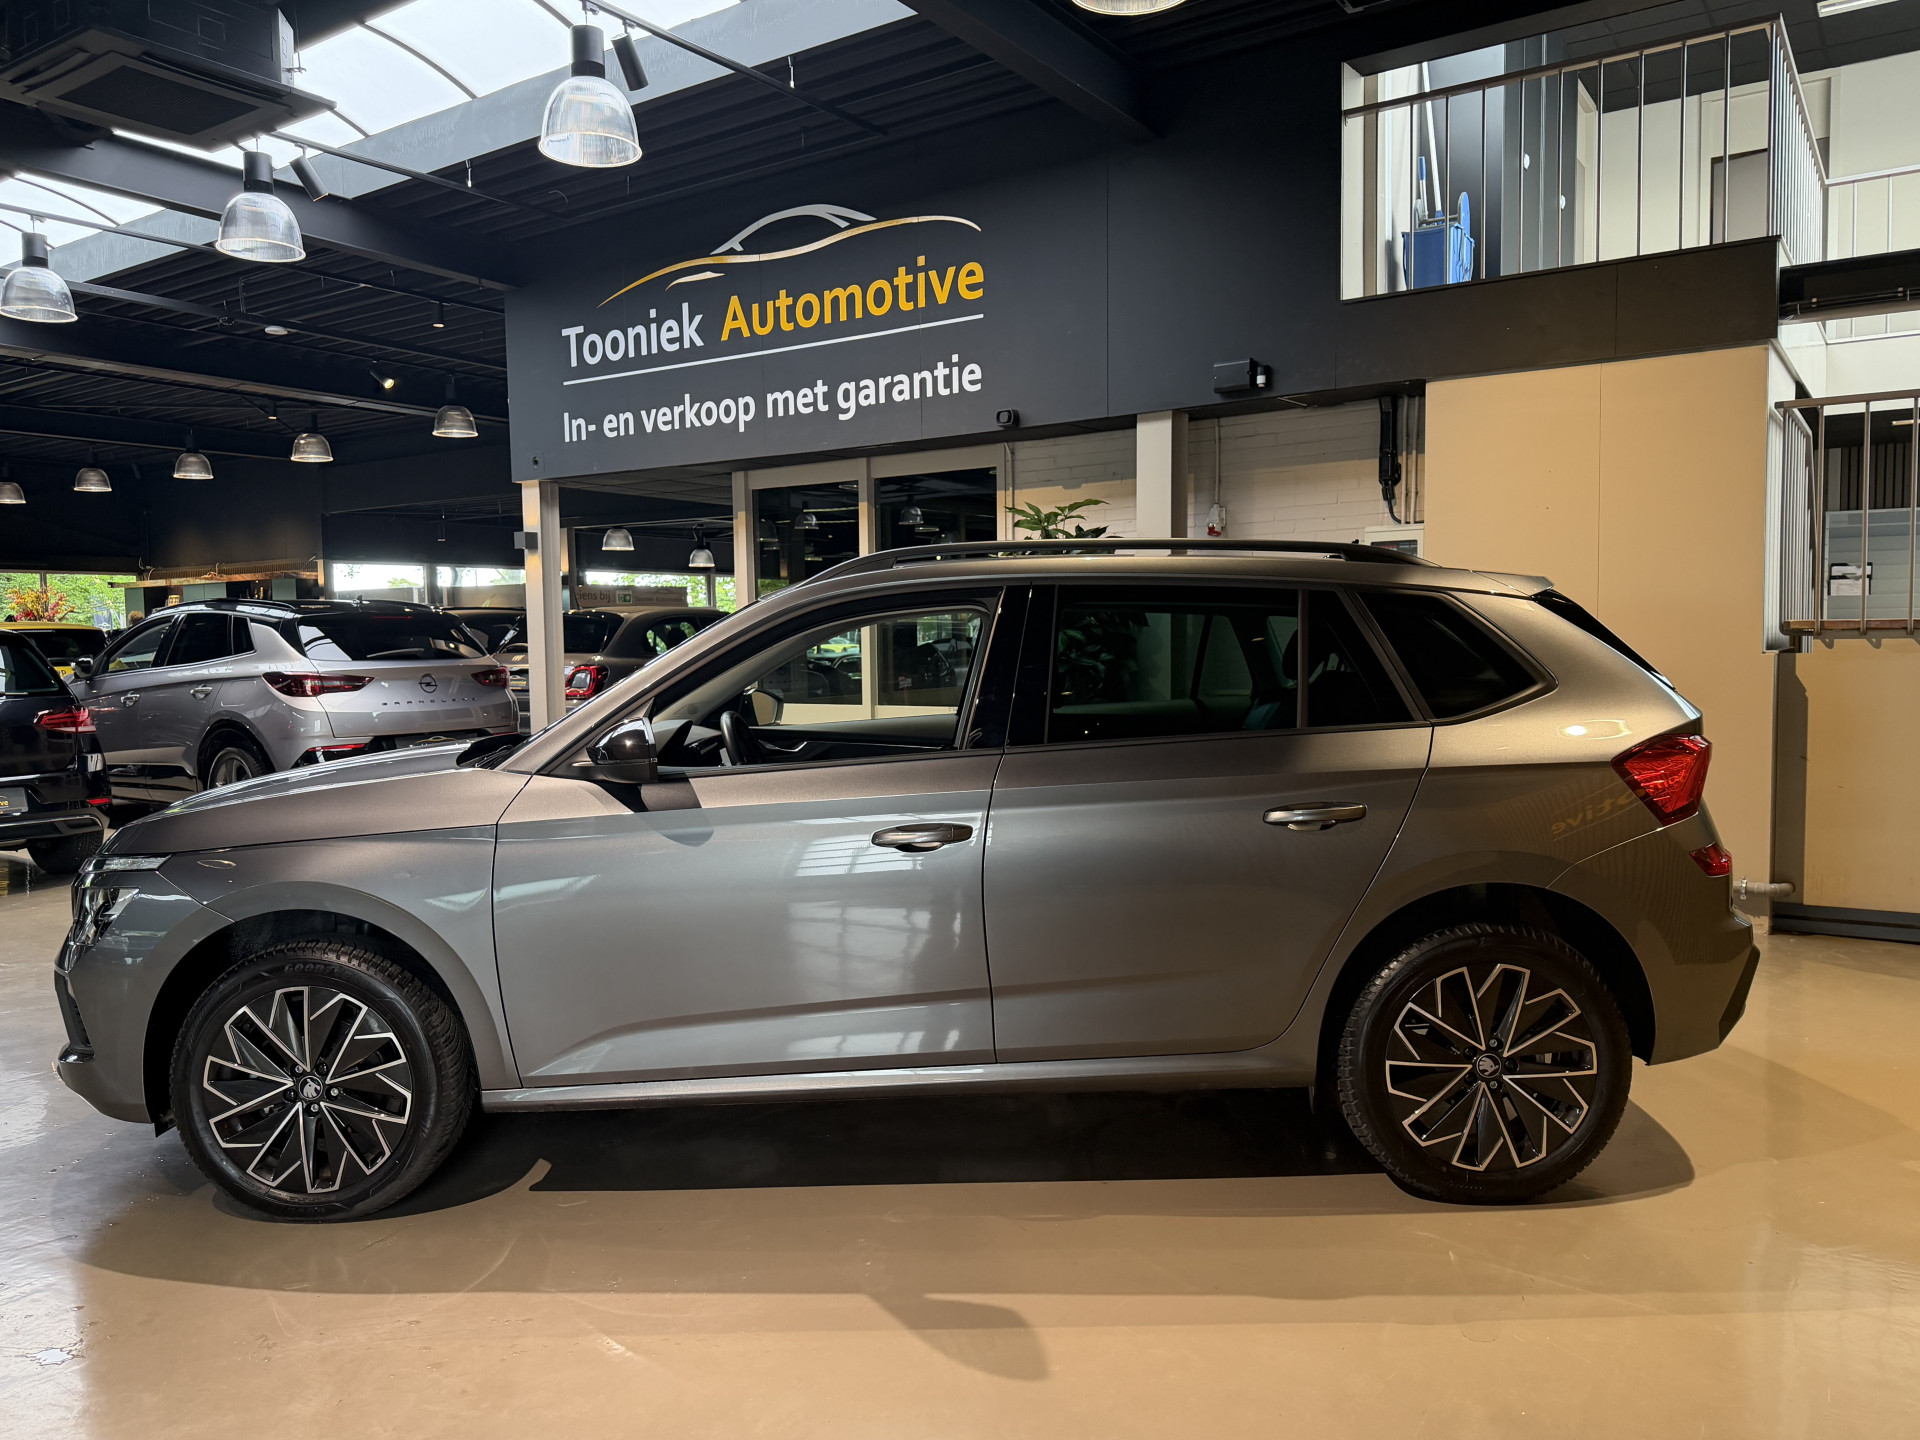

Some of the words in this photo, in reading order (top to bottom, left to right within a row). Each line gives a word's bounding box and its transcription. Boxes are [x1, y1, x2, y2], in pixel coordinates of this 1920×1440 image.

[562, 302, 705, 368] Tooniek
[721, 255, 985, 342] Automotive
[563, 411, 597, 443] In-
[602, 412, 635, 438] en
[639, 393, 756, 433] verkoop
[766, 379, 829, 419] met
[836, 353, 983, 421] garantie
